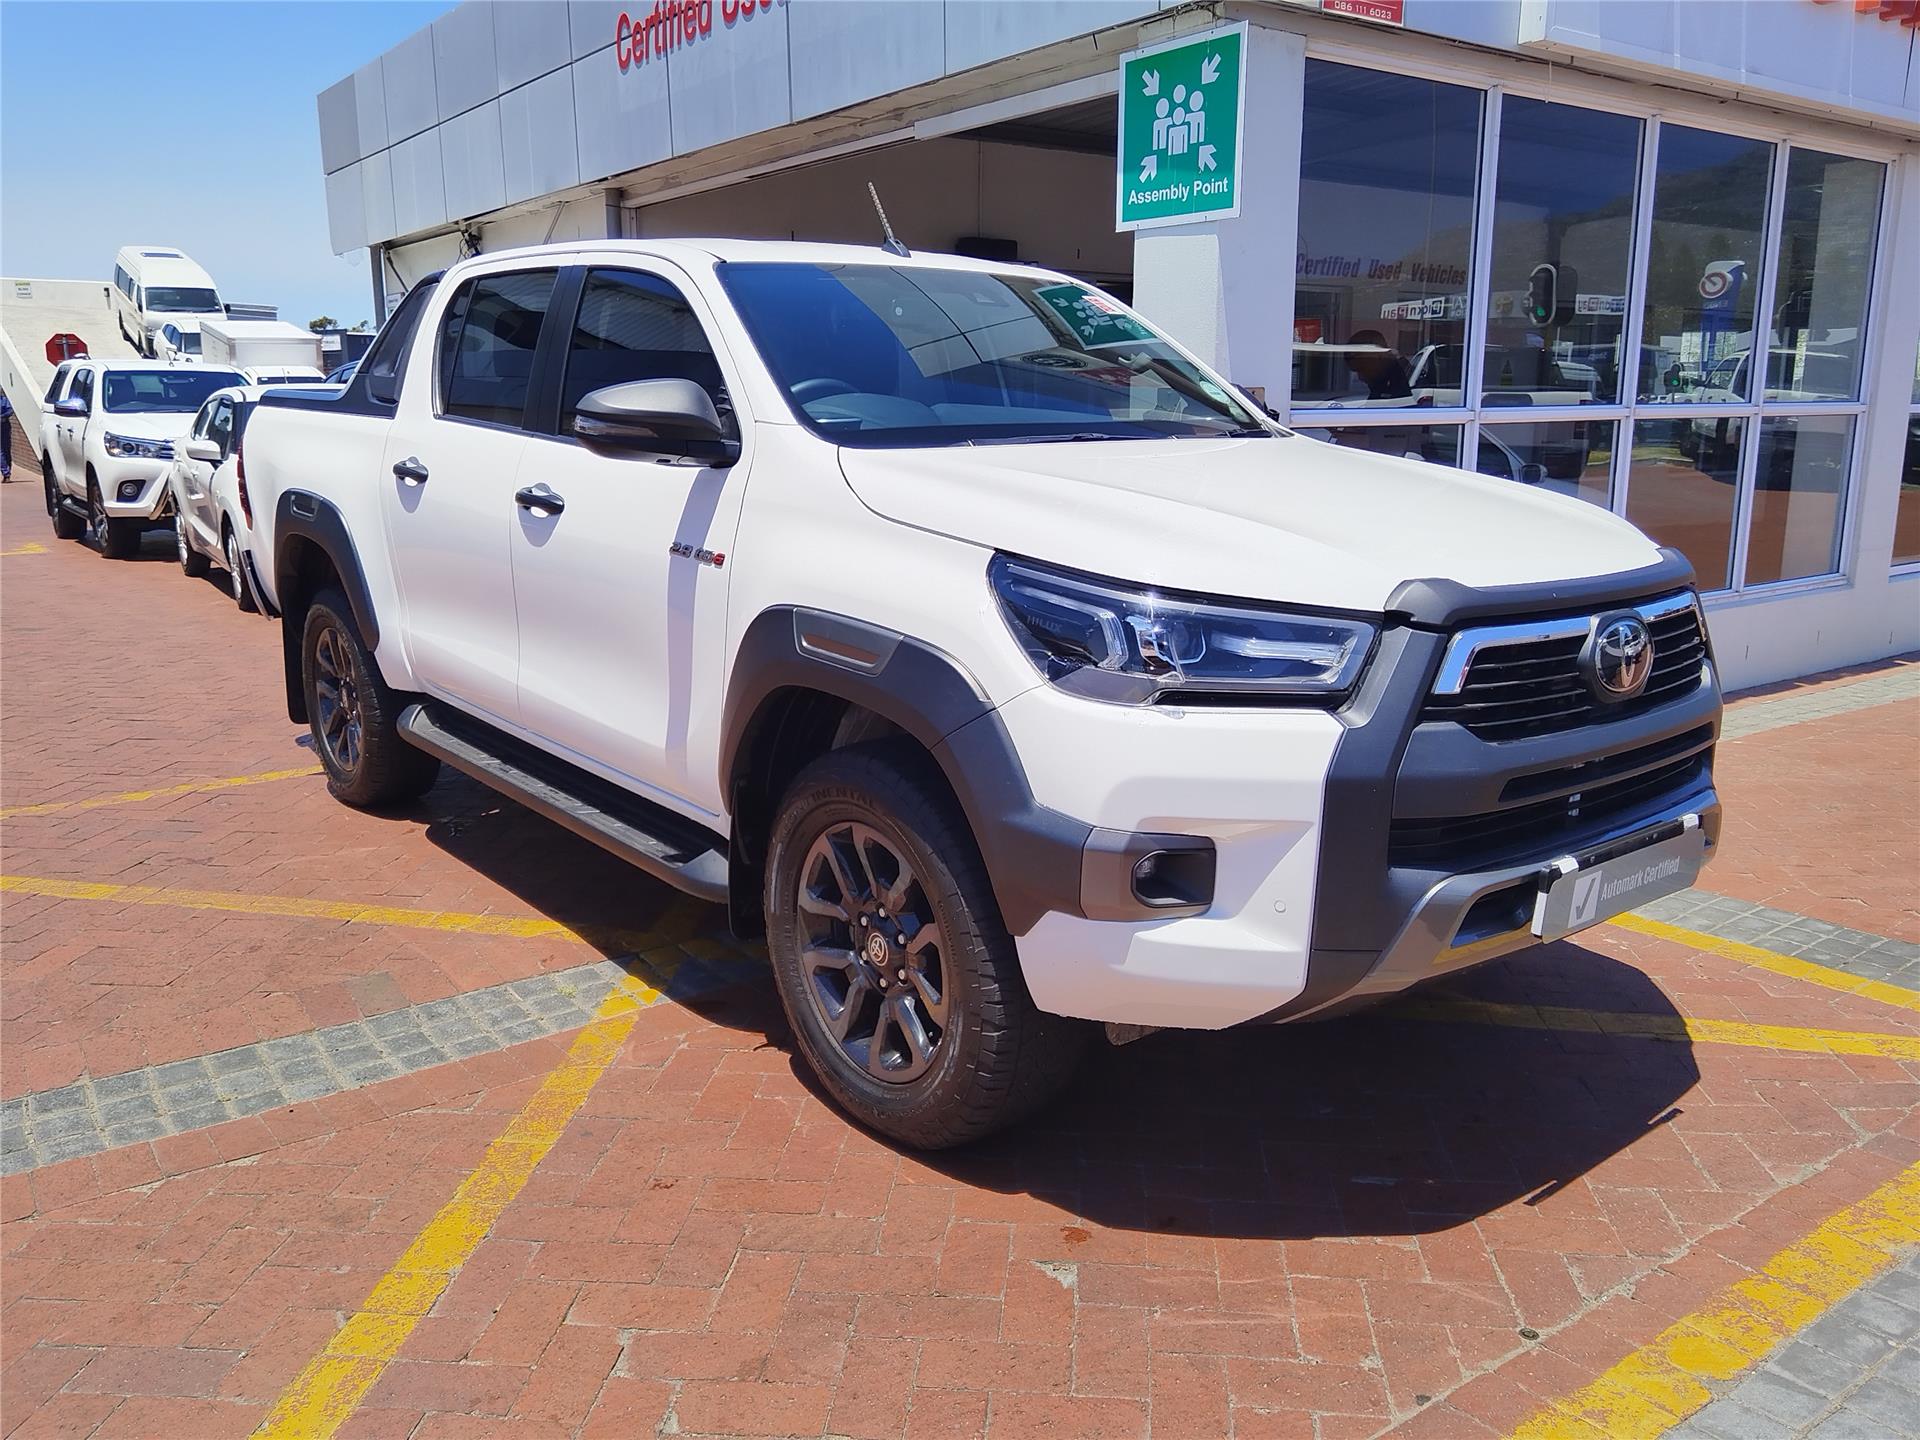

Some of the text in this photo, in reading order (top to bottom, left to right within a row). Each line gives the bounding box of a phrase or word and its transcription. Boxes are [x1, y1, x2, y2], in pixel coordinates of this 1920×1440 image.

[1334, 1, 1392, 20] 086 111 6023
[616, 0, 712, 70] Certified
[1127, 176, 1229, 206] Assembly Point
[1296, 253, 1467, 286] Certified Used Vehicles
[1600, 856, 1681, 902] Automark Certified
